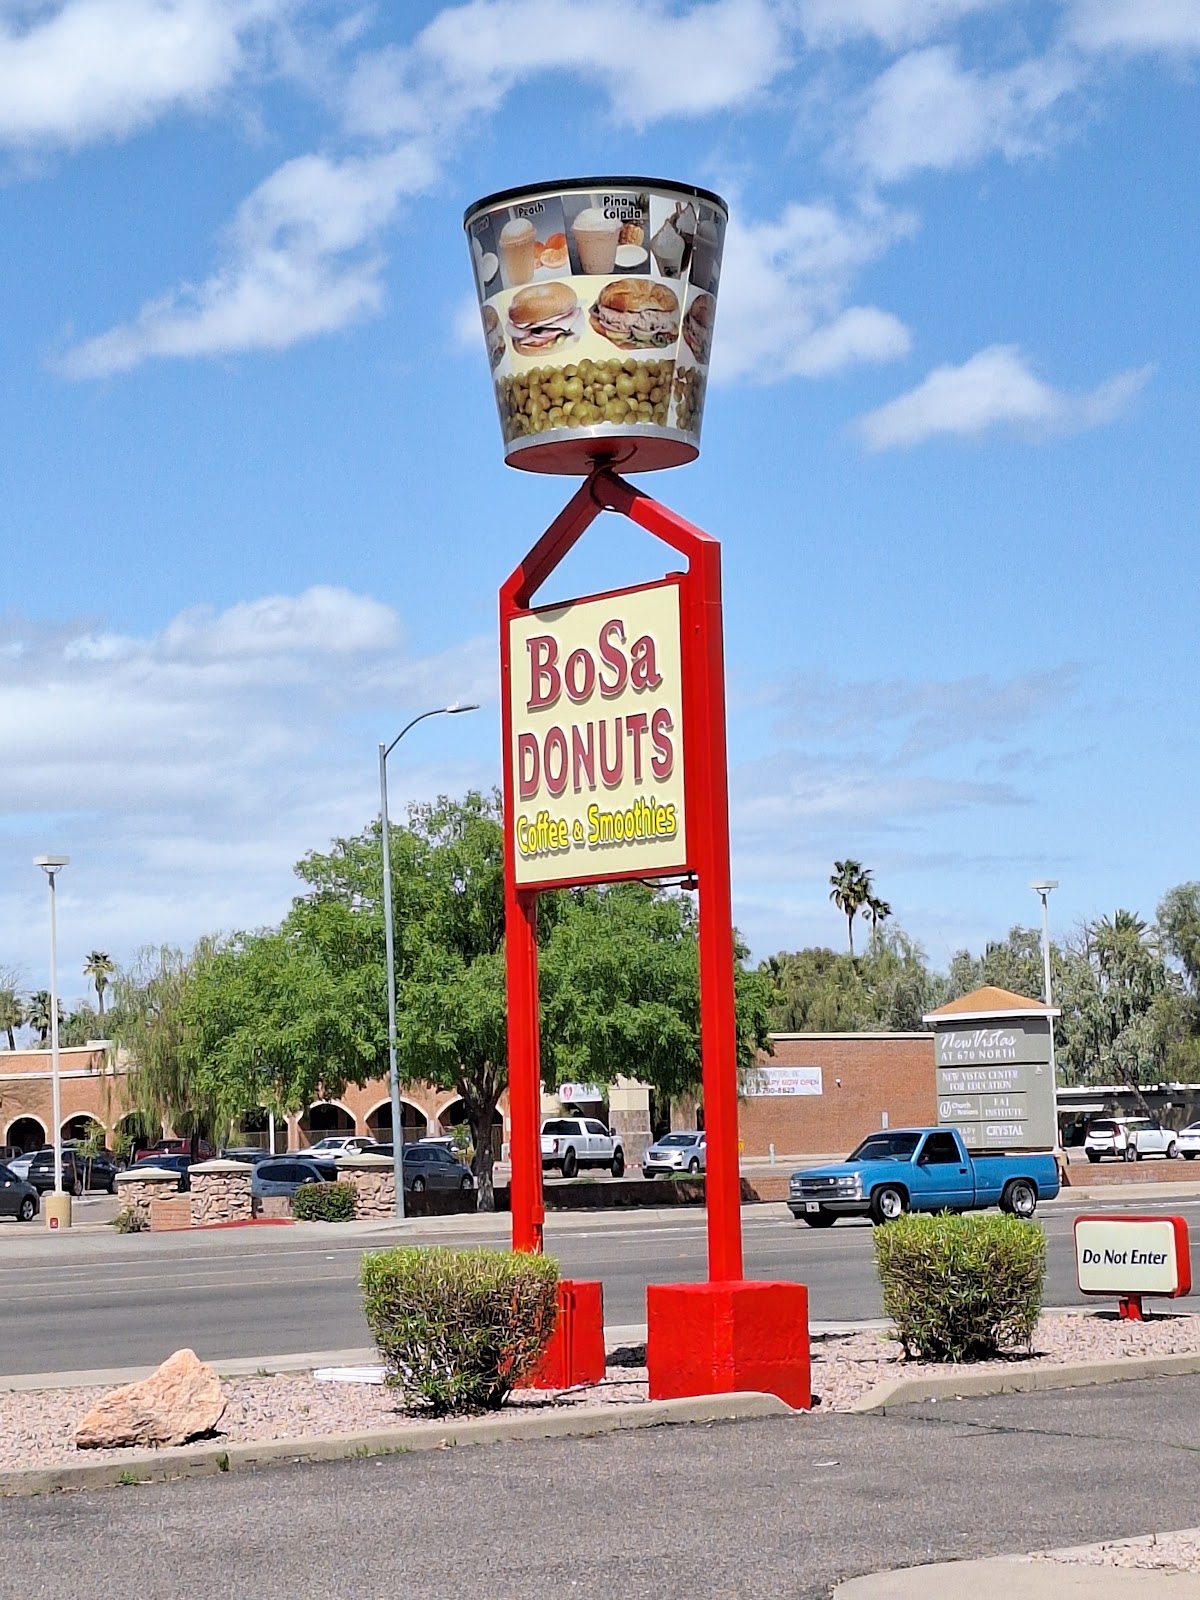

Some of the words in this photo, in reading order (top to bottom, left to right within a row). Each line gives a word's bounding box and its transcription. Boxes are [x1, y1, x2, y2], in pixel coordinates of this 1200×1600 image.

[518, 202, 544, 217] Peach
[603, 207, 641, 220] Colada
[526, 619, 663, 710] BoSa
[518, 708, 674, 798] DONUTS
[517, 810, 568, 854] Coffee
[573, 818, 584, 842] &
[587, 795, 677, 843] Smoothies
[941, 1033, 972, 1050] New
[973, 1029, 1017, 1048] Vistas
[941, 1051, 953, 1062] AT
[957, 1050, 975, 1060] 670
[979, 1048, 1016, 1059] NORTH
[942, 1071, 959, 1081] NEW
[961, 1070, 987, 1081] VISTAS
[988, 1069, 1019, 1079] CENTER
[950, 1082, 965, 1091] FOR
[967, 1080, 1012, 1091] EDUCATION
[985, 1107, 1023, 1117] INSTITUTE
[986, 1124, 1024, 1136] CRYSTAL
[1082, 1249, 1101, 1264] Do
[1104, 1249, 1127, 1264] Not
[1131, 1249, 1168, 1265] Enter
